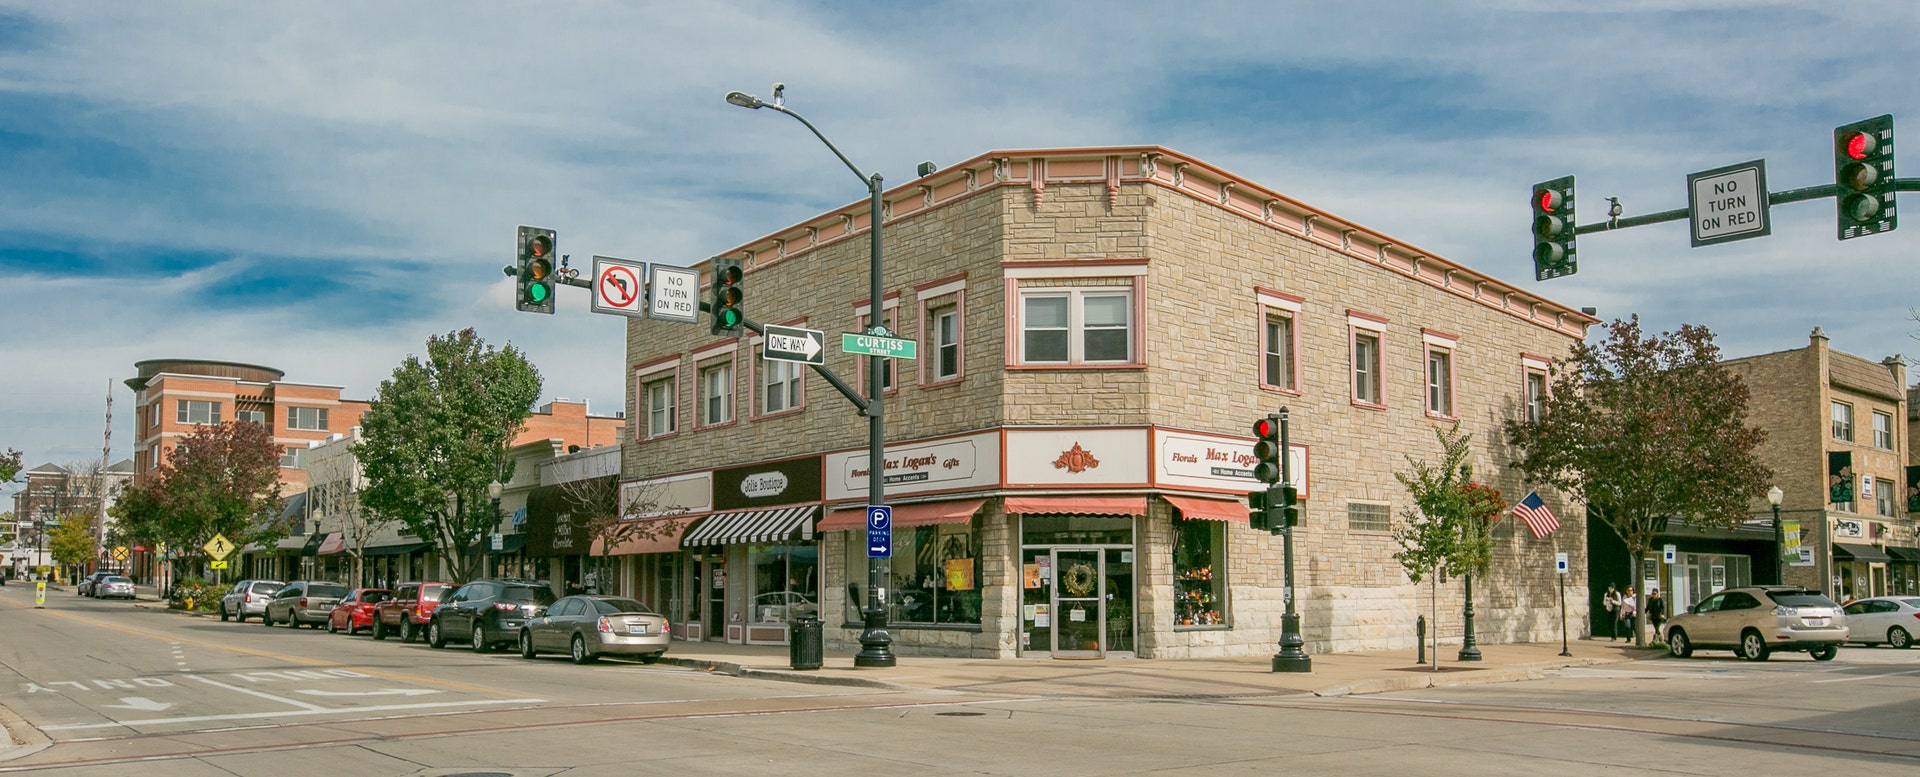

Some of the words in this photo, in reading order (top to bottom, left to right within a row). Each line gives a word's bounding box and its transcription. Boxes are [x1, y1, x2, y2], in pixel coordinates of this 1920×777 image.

[1714, 180, 1737, 195] NO
[1708, 195, 1746, 212] TURN
[1702, 217, 1720, 230] ON
[1728, 211, 1755, 226] RED
[668, 276, 683, 286] NO
[663, 288, 687, 299] TURN
[657, 300, 669, 309] ON
[673, 302, 691, 312] RED
[771, 336, 787, 350] ONE
[790, 338, 807, 352] WAY
[857, 337, 903, 351] CURTISS
[1172, 452, 1198, 463] Florals
[1205, 447, 1229, 462] Max
[1231, 450, 1261, 468] Logan
[851, 468, 871, 478] Floral
[902, 453, 937, 471] Logan's
[943, 457, 960, 469] Gifts
[1220, 468, 1233, 476] Home
[1235, 469, 1253, 478] Accents
[745, 479, 758, 492] Jolie
[760, 477, 783, 492] Boutique
[875, 512, 884, 525] P
[26, 678, 174, 693] ONLY
